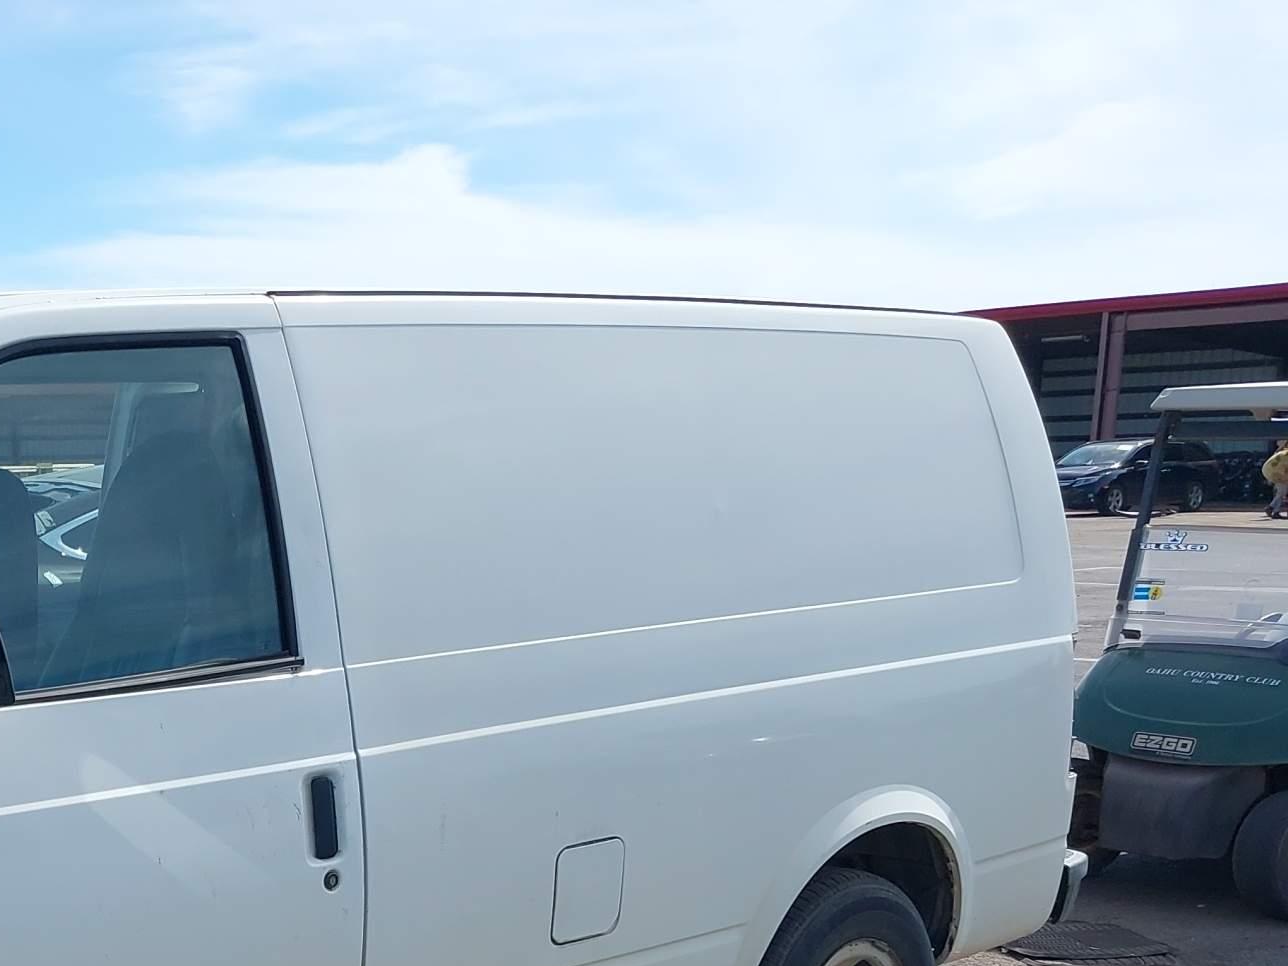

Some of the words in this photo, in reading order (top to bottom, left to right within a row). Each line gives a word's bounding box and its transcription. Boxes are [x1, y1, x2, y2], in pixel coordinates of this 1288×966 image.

[1139, 543, 1208, 551] BLESSED
[1145, 667, 1180, 675] OAHU
[1183, 670, 1242, 682] COUNTRY
[1246, 676, 1281, 686] CLUB
